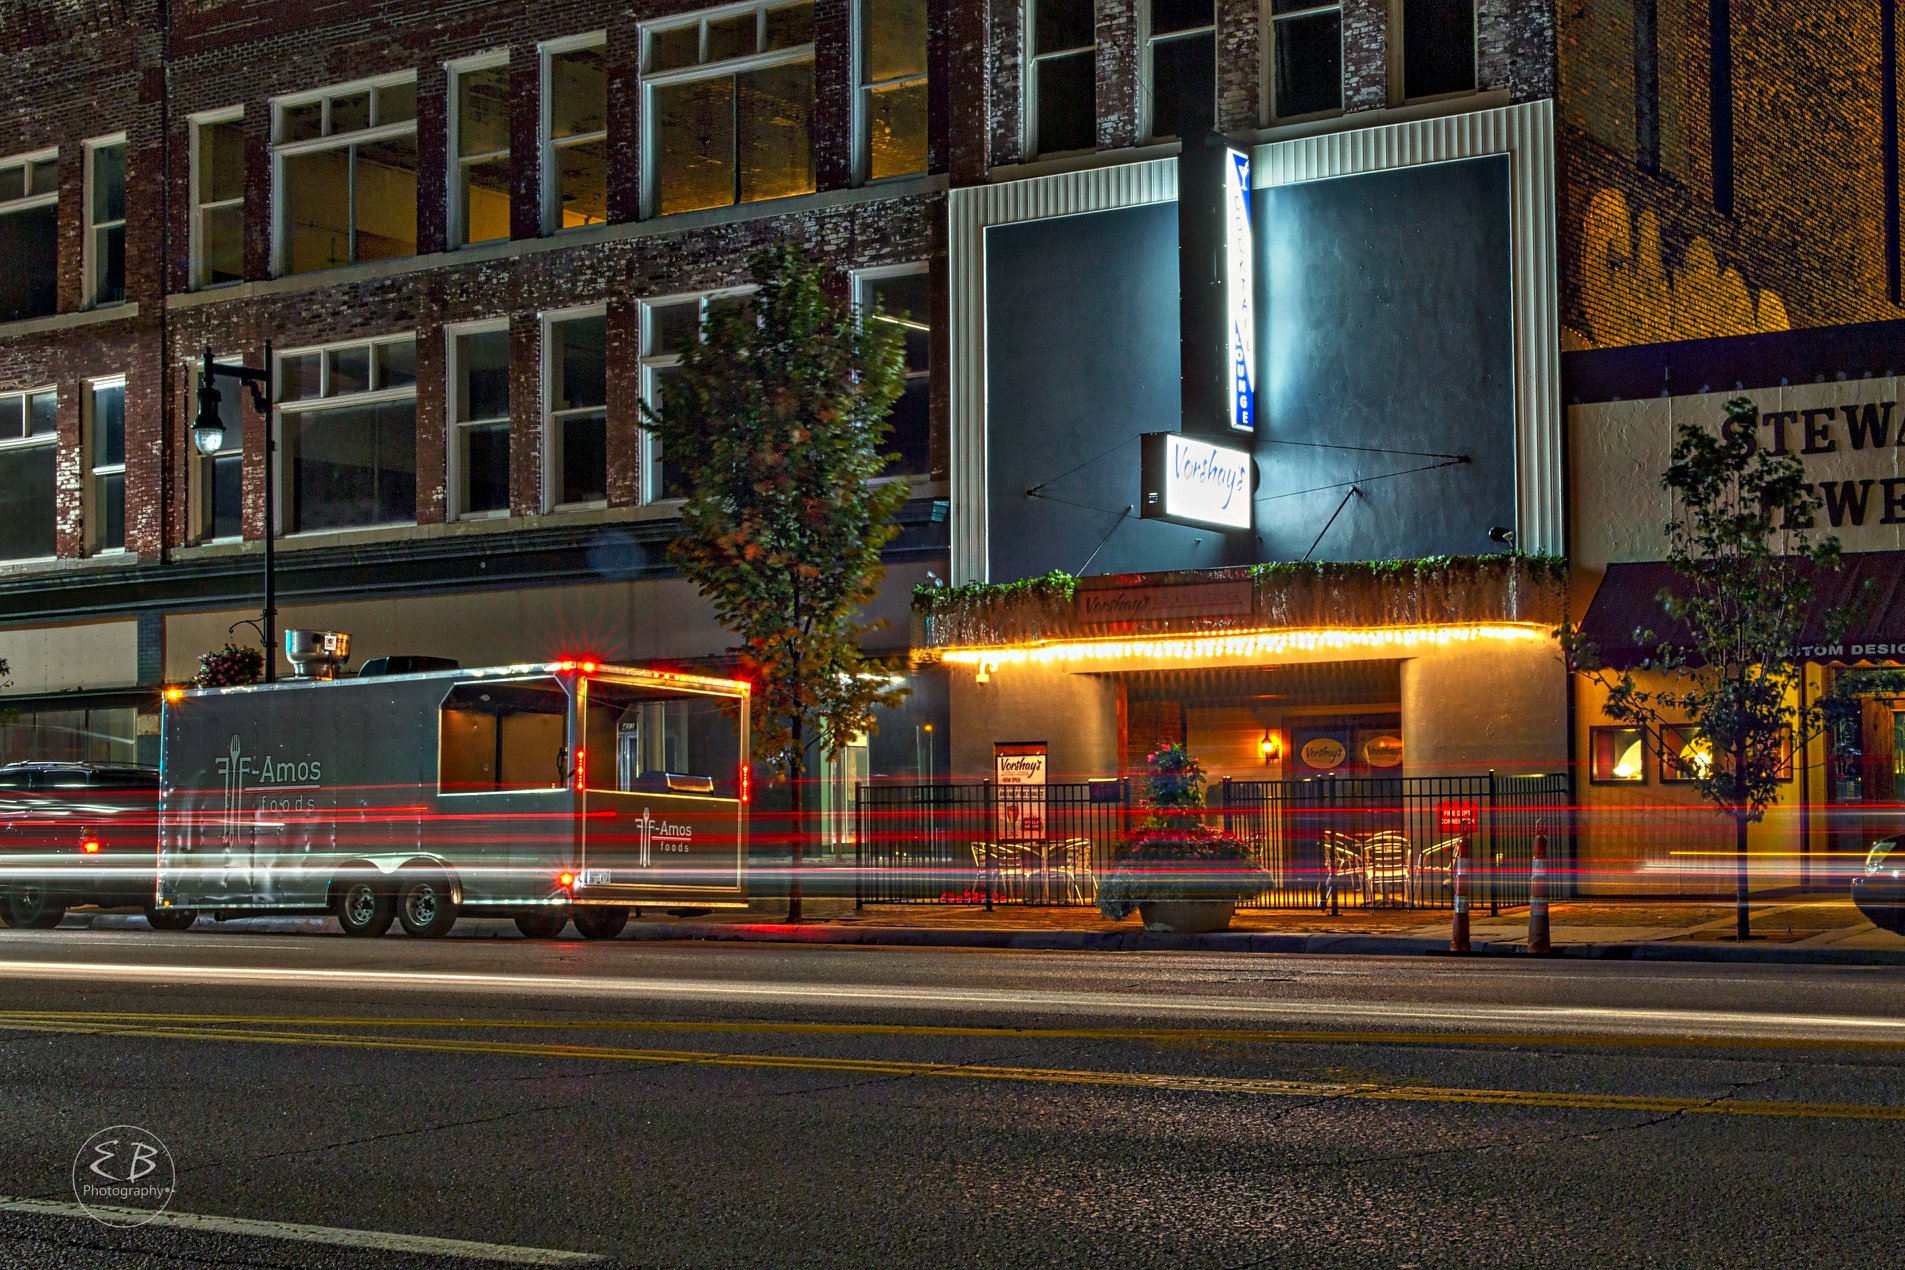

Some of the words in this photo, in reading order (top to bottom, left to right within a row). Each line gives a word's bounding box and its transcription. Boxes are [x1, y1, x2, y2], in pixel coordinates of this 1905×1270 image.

[1234, 195, 1251, 352] COCKTAIL
[1235, 331, 1249, 424] LOUNGE
[1722, 402, 1905, 461] STEW
[1175, 443, 1246, 510] Vorshay's
[1085, 592, 1150, 618] Vorshay's
[1202, 591, 1241, 602] LOUNGE
[1001, 757, 1042, 778] Vorshay's
[1306, 746, 1344, 763] Vorshay's
[261, 795, 315, 813] foods
[660, 842, 690, 852] foods
